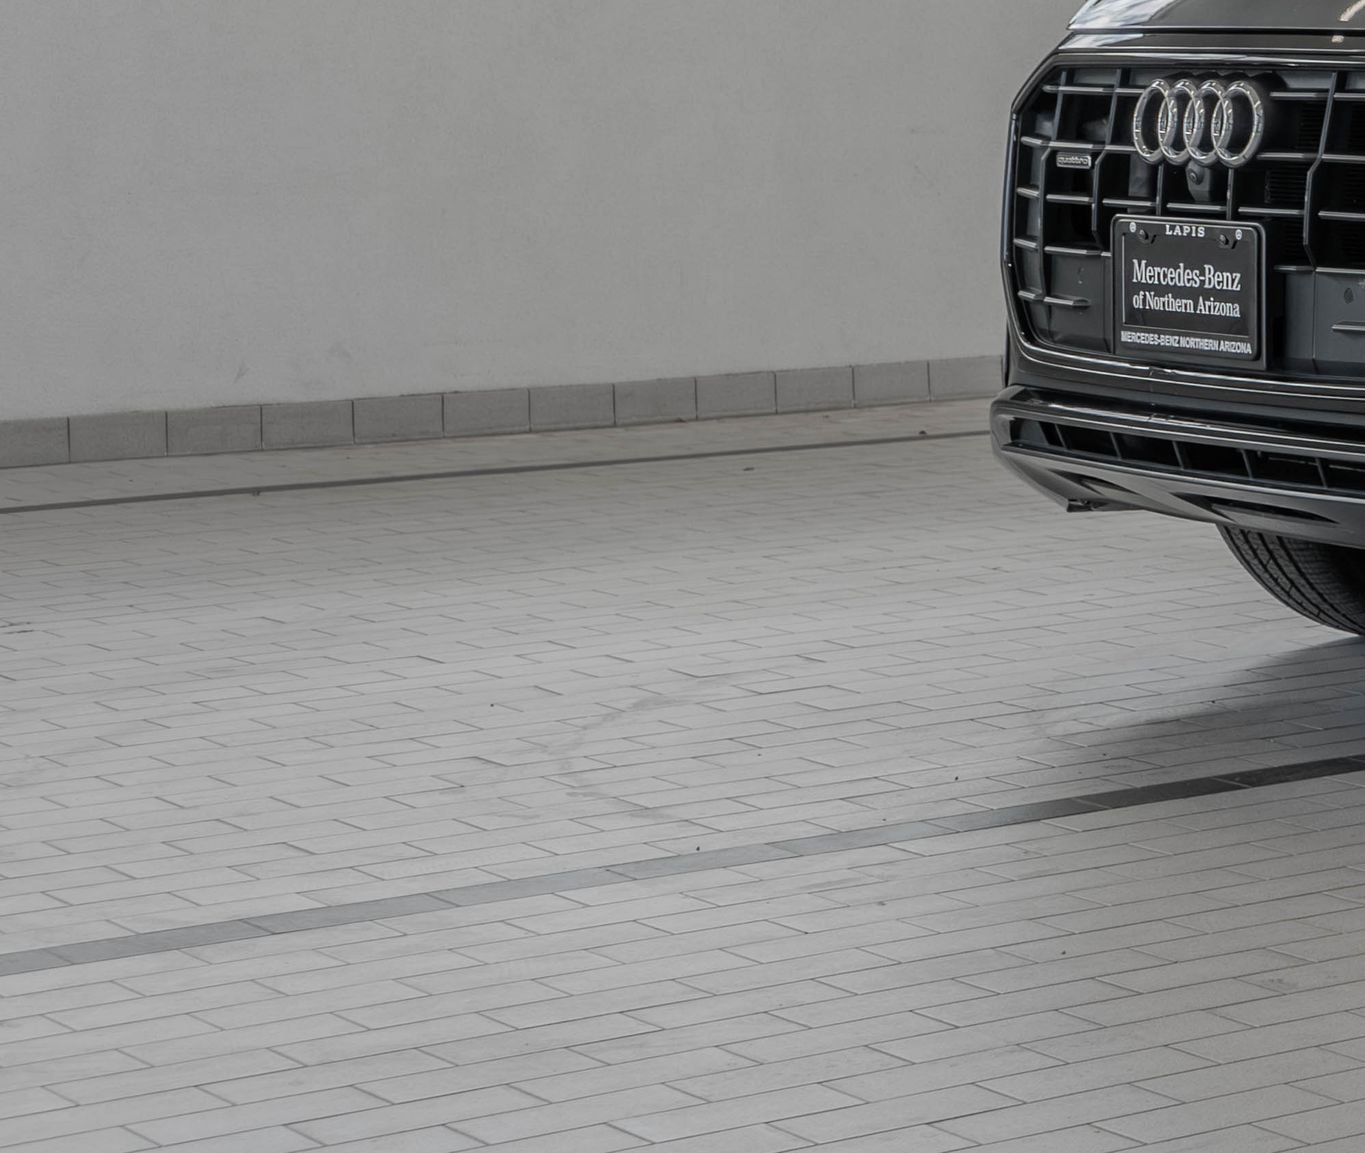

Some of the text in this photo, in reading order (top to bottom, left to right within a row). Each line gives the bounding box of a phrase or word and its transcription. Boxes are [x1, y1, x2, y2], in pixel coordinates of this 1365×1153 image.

[1165, 224, 1205, 238] LAPIS
[1132, 259, 1241, 291] Mercedes-Benz
[1132, 291, 1241, 318] of Northern Arizona
[1120, 330, 1252, 354] MERCEDES-BENZ NORTHERN ARIZONA
